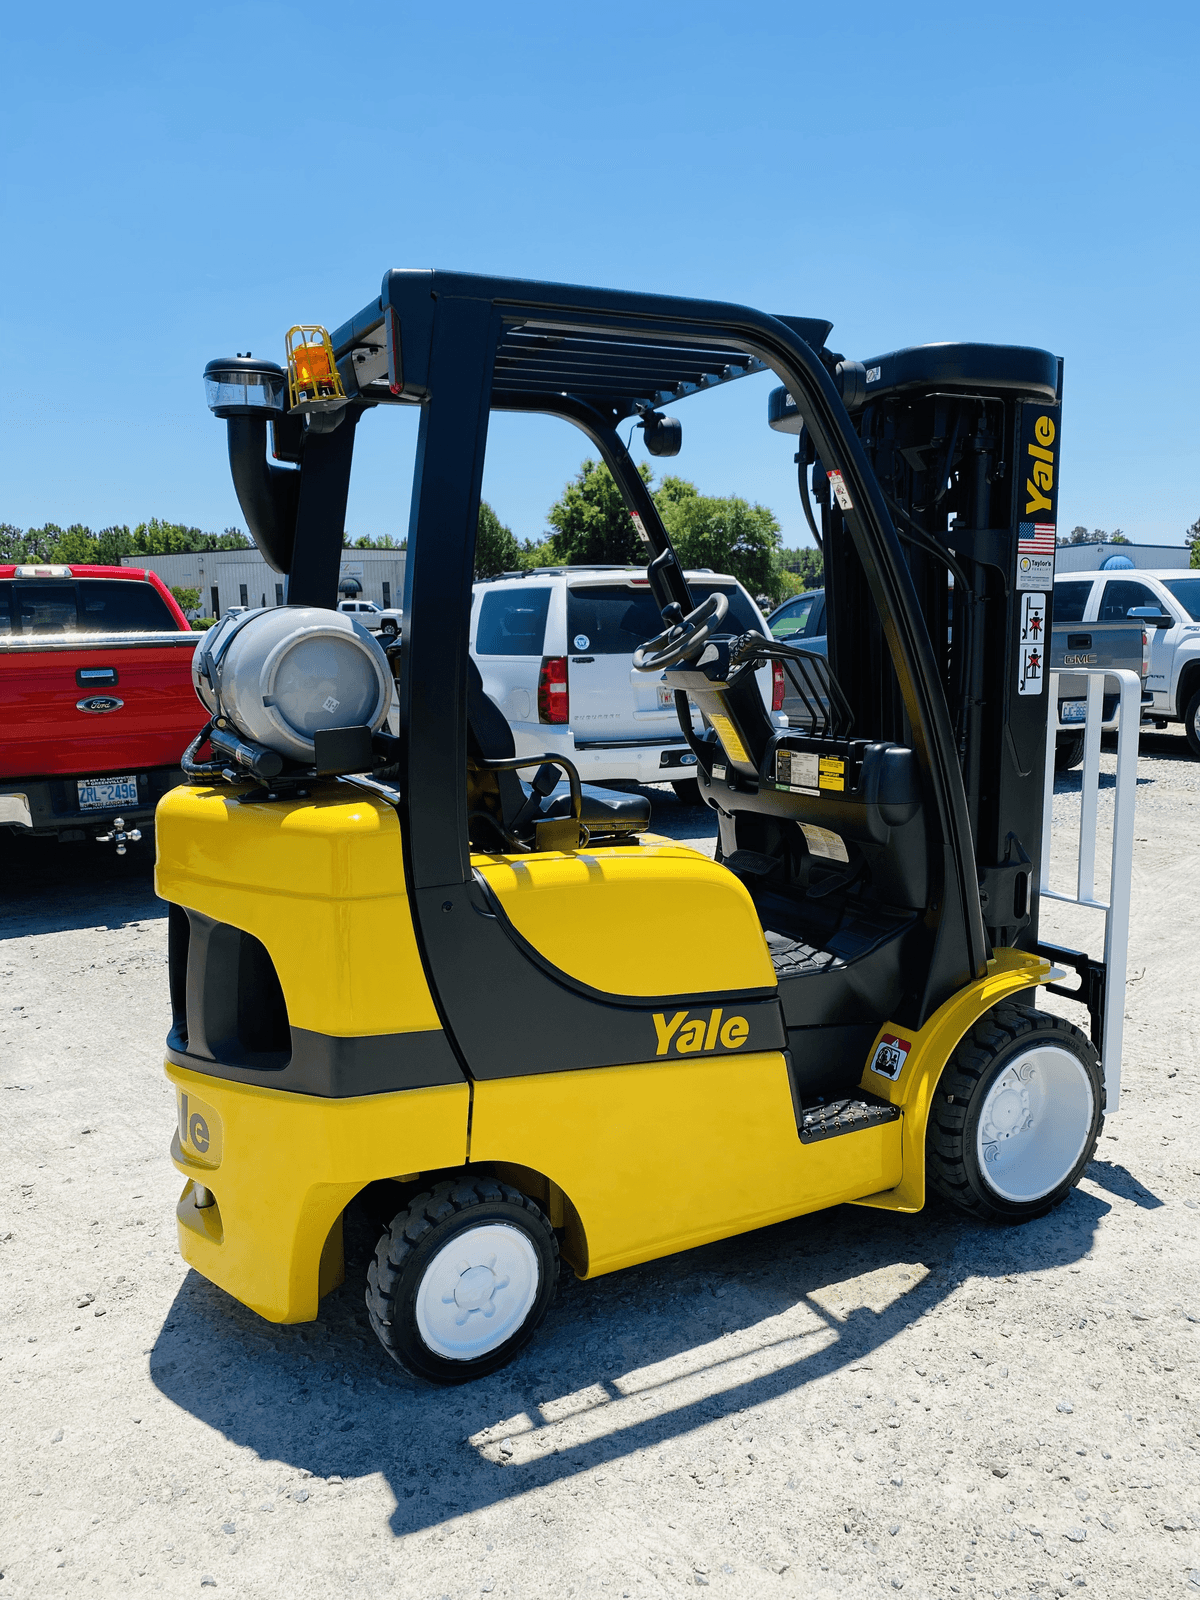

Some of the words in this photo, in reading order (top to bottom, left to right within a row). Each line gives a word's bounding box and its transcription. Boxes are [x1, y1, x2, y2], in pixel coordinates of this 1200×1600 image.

[1026, 416, 1055, 514] Yale
[1031, 559, 1052, 568] Taylor's
[1064, 653, 1097, 664] GMC
[90, 700, 111, 709] Ford
[78, 784, 137, 803] ZRL-2496
[652, 1008, 750, 1056] Yale
